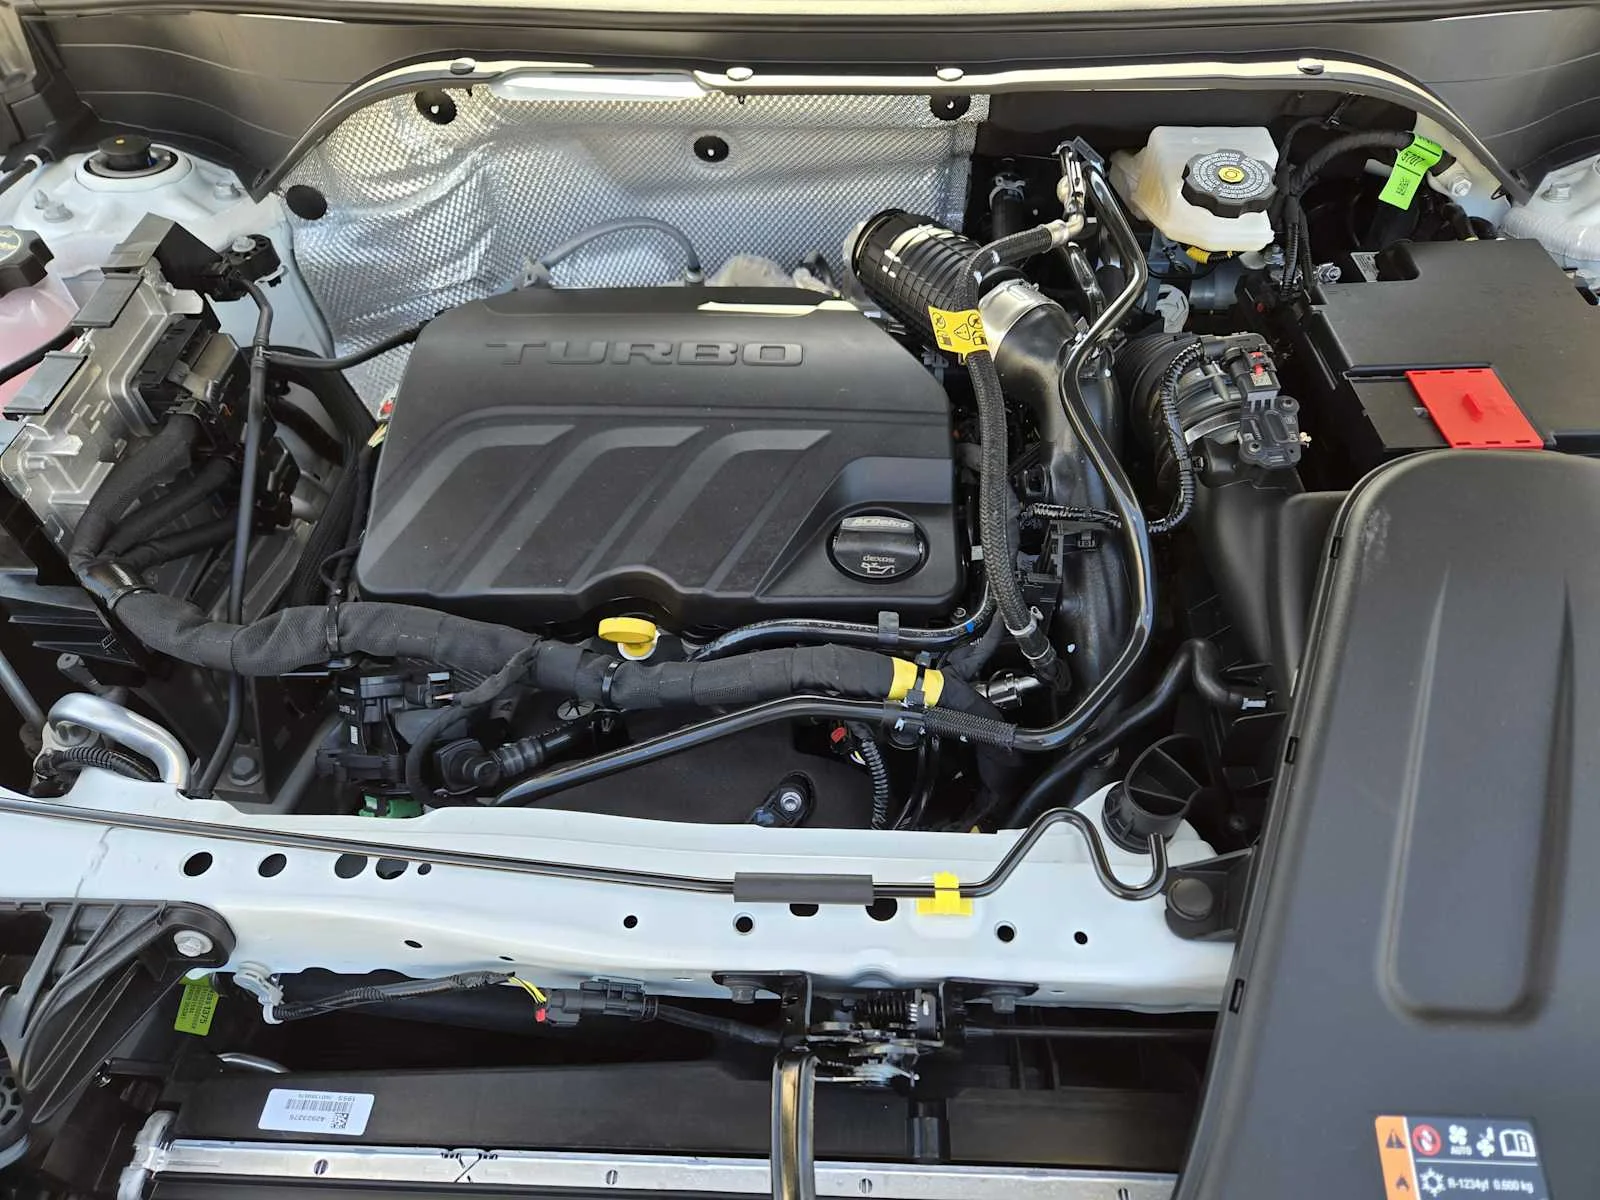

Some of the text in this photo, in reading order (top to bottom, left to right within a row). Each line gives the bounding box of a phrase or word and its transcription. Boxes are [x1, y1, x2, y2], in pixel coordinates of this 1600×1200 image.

[485, 341, 804, 367] TURBO
[862, 554, 896, 564] dexos
[1520, 1180, 1534, 1194] kg
